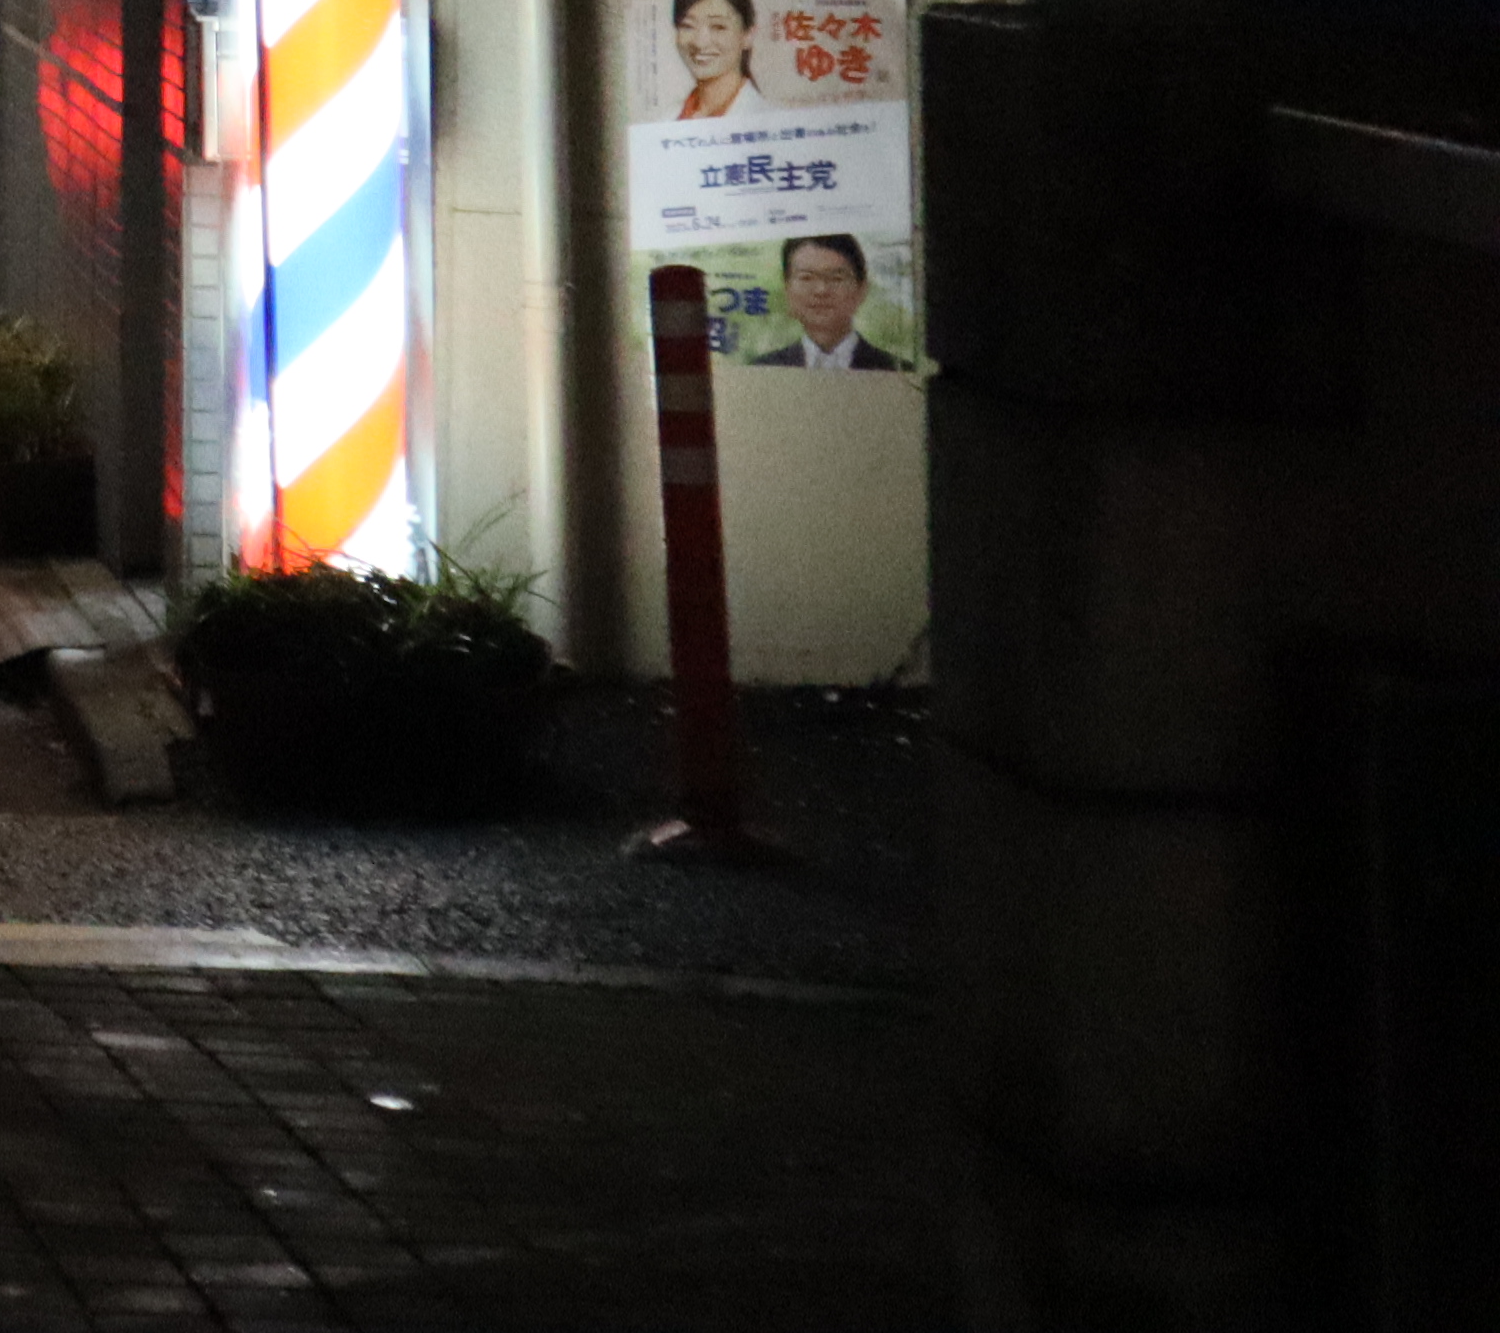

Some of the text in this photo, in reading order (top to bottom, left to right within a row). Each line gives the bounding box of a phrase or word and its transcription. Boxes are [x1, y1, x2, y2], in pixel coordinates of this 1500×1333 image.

[784, 10, 882, 42] 佐々木
[795, 44, 873, 84] ゆき
[699, 154, 838, 192] 立憲民主党
[708, 287, 771, 316] つま
